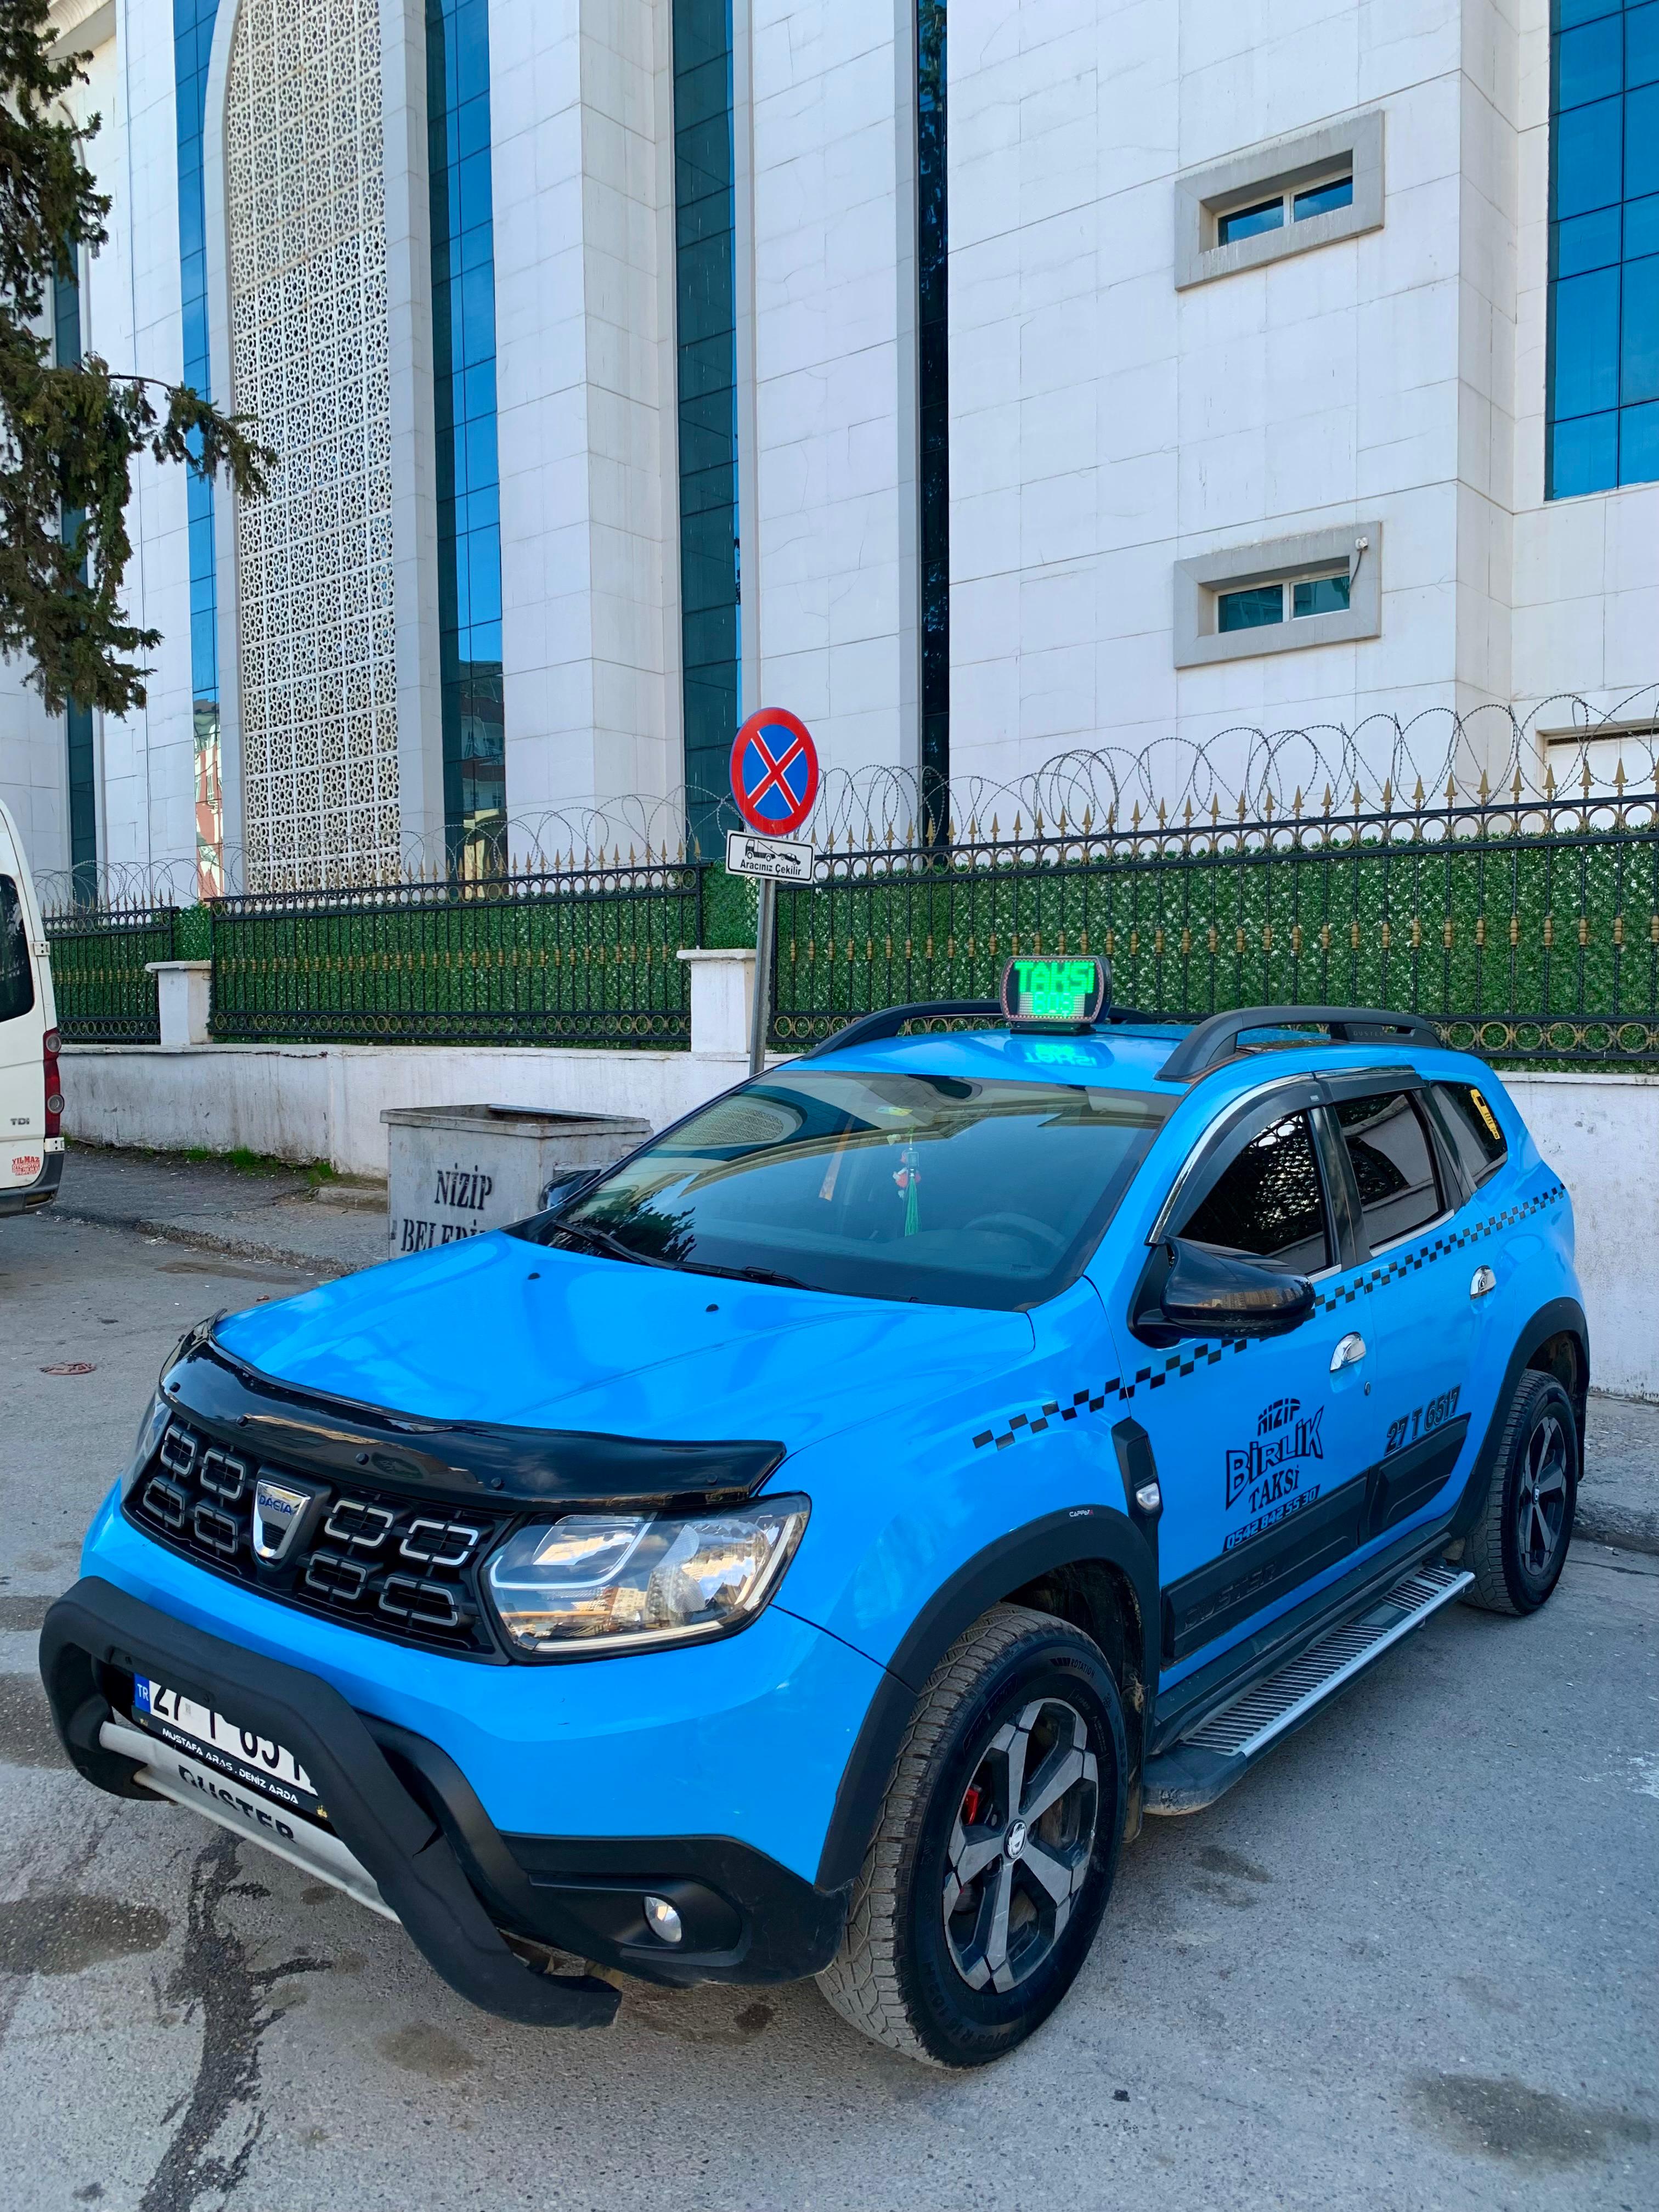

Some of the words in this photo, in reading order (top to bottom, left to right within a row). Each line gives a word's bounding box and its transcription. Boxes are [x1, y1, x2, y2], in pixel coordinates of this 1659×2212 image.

[740, 859, 772, 871] Aracınız
[775, 864, 802, 875] Çekilir
[434, 1163, 492, 1210] NİZİP
[1384, 1413, 1410, 1457] 27
[1412, 1406, 1423, 1440] T
[258, 1494, 293, 1515] DACIA
[1226, 1520, 1259, 1550] 0542
[1261, 1505, 1284, 1529] 842
[1302, 1487, 1317, 1506] 30
[1070, 1659, 1095, 1678] ROTATION
[137, 1684, 149, 1701] TR
[162, 1728, 203, 1756] MUSTAFA
[206, 1752, 233, 1771] ARAS
[239, 1768, 266, 1788] DENİZ
[269, 1784, 298, 1804] ARDA
